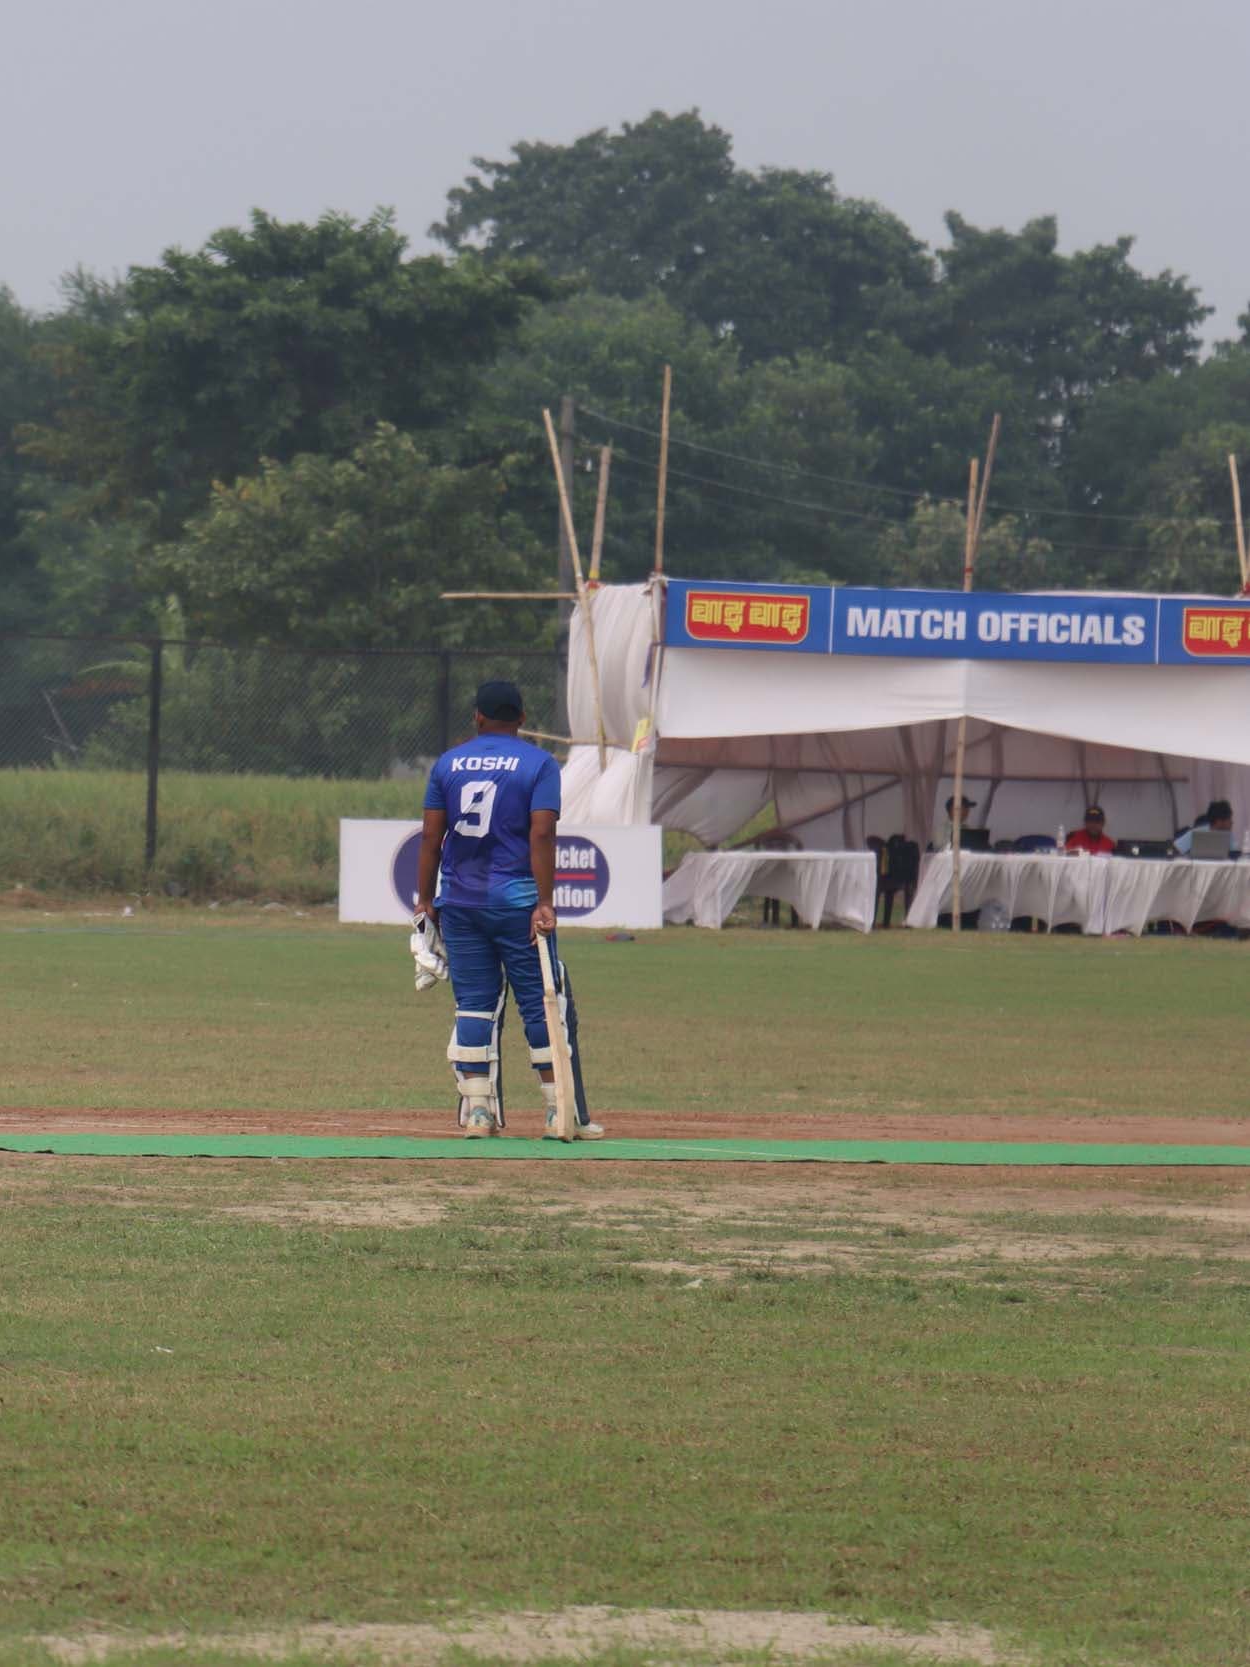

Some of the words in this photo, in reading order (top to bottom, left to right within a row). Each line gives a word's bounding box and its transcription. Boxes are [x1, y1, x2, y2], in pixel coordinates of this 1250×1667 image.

[847, 607, 966, 640] MATCH
[977, 611, 1146, 646] OFFICIALS
[451, 756, 520, 772] KOSHI
[454, 781, 498, 838] 9
[555, 845, 597, 869] icket
